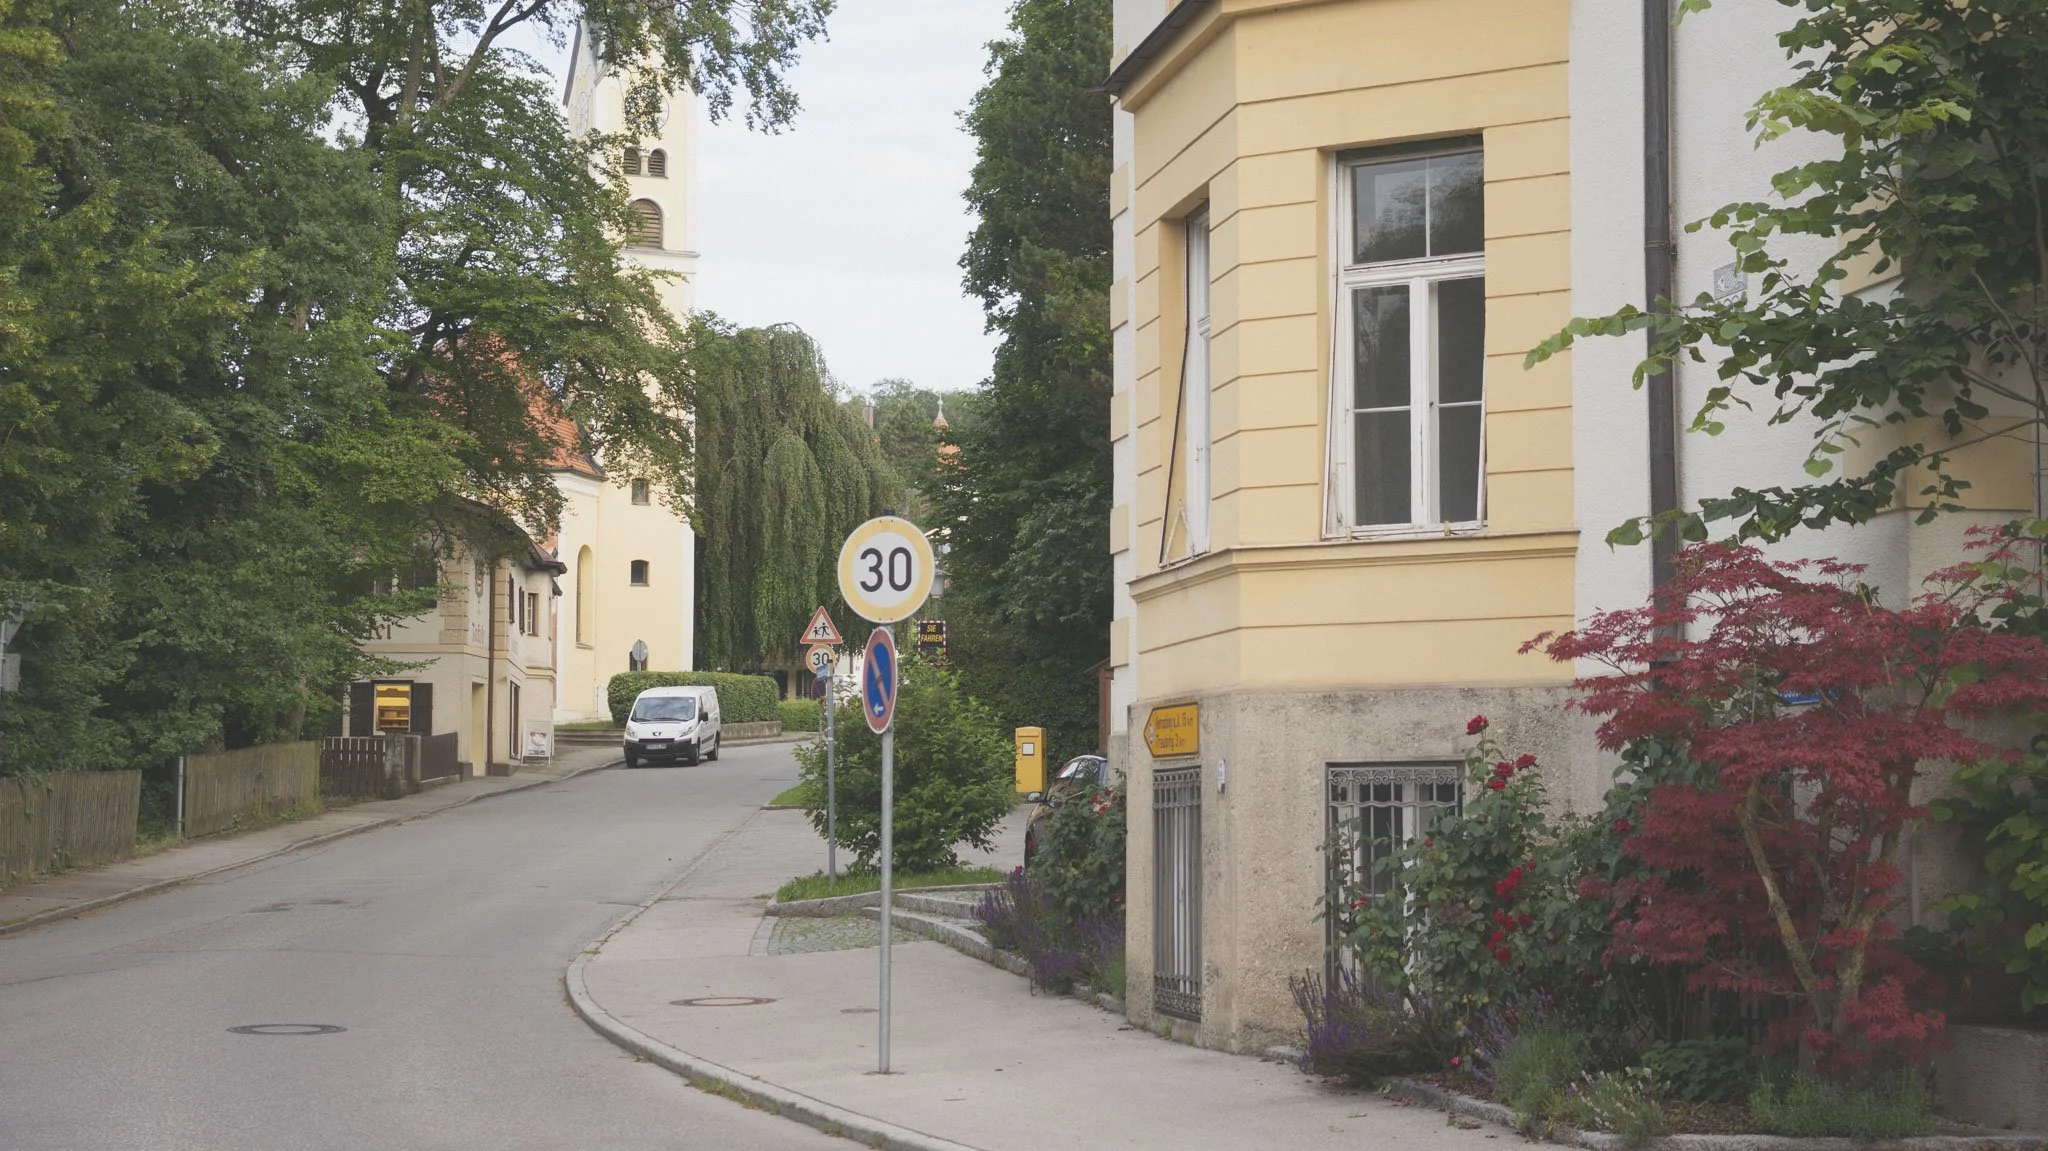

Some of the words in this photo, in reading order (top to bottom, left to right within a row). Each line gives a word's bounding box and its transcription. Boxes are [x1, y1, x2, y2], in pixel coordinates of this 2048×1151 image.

[860, 547, 912, 592] 30
[926, 624, 937, 633] SIE
[920, 634, 943, 643] FAHREN
[812, 652, 830, 666] 30
